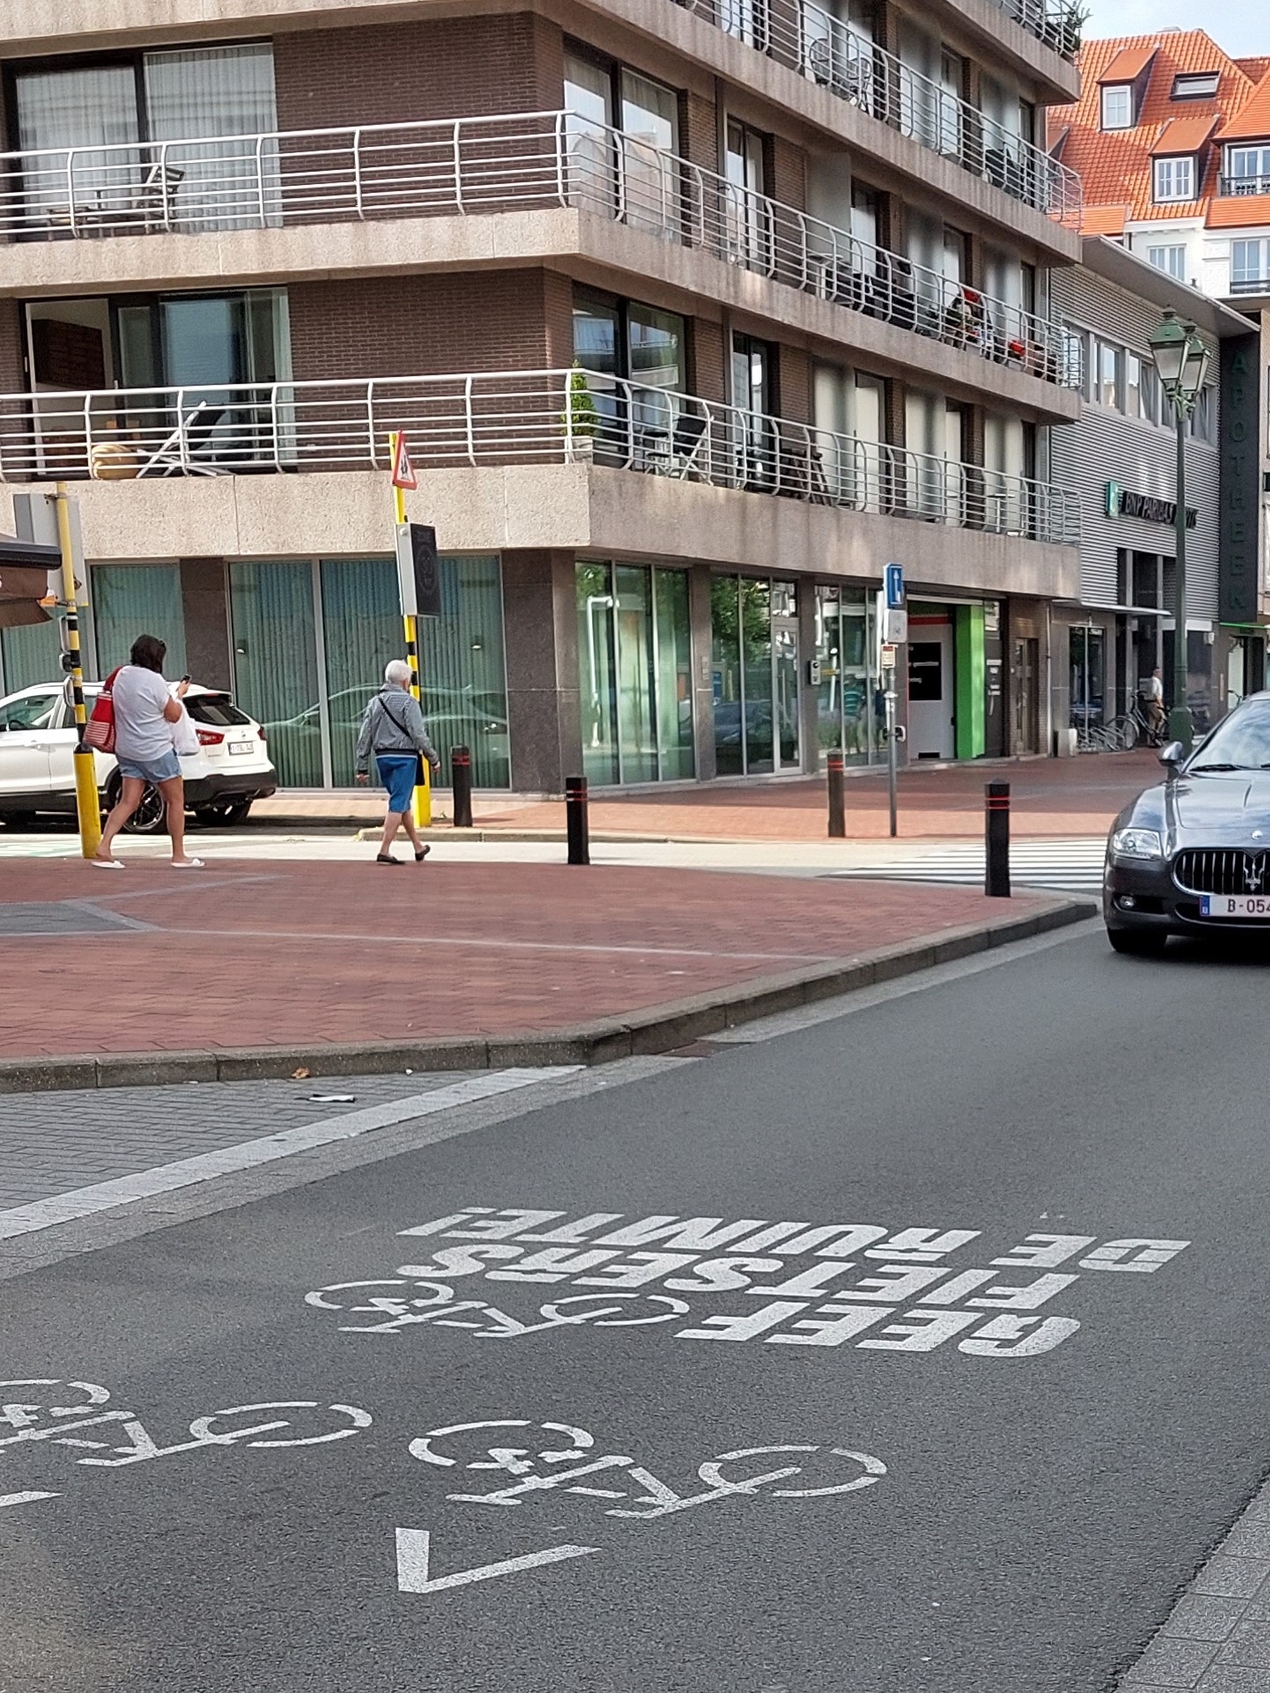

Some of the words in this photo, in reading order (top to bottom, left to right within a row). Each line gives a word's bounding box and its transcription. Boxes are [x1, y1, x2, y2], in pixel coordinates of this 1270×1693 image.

[1125, 492, 1142, 516] BNP
[1229, 349, 1249, 612] APOTHEEK
[396, 1207, 982, 1262] RUIMTE!
[989, 1233, 1192, 1273] DE
[396, 1244, 1081, 1310] FIETSERS
[673, 1301, 1081, 1357] GEEF
